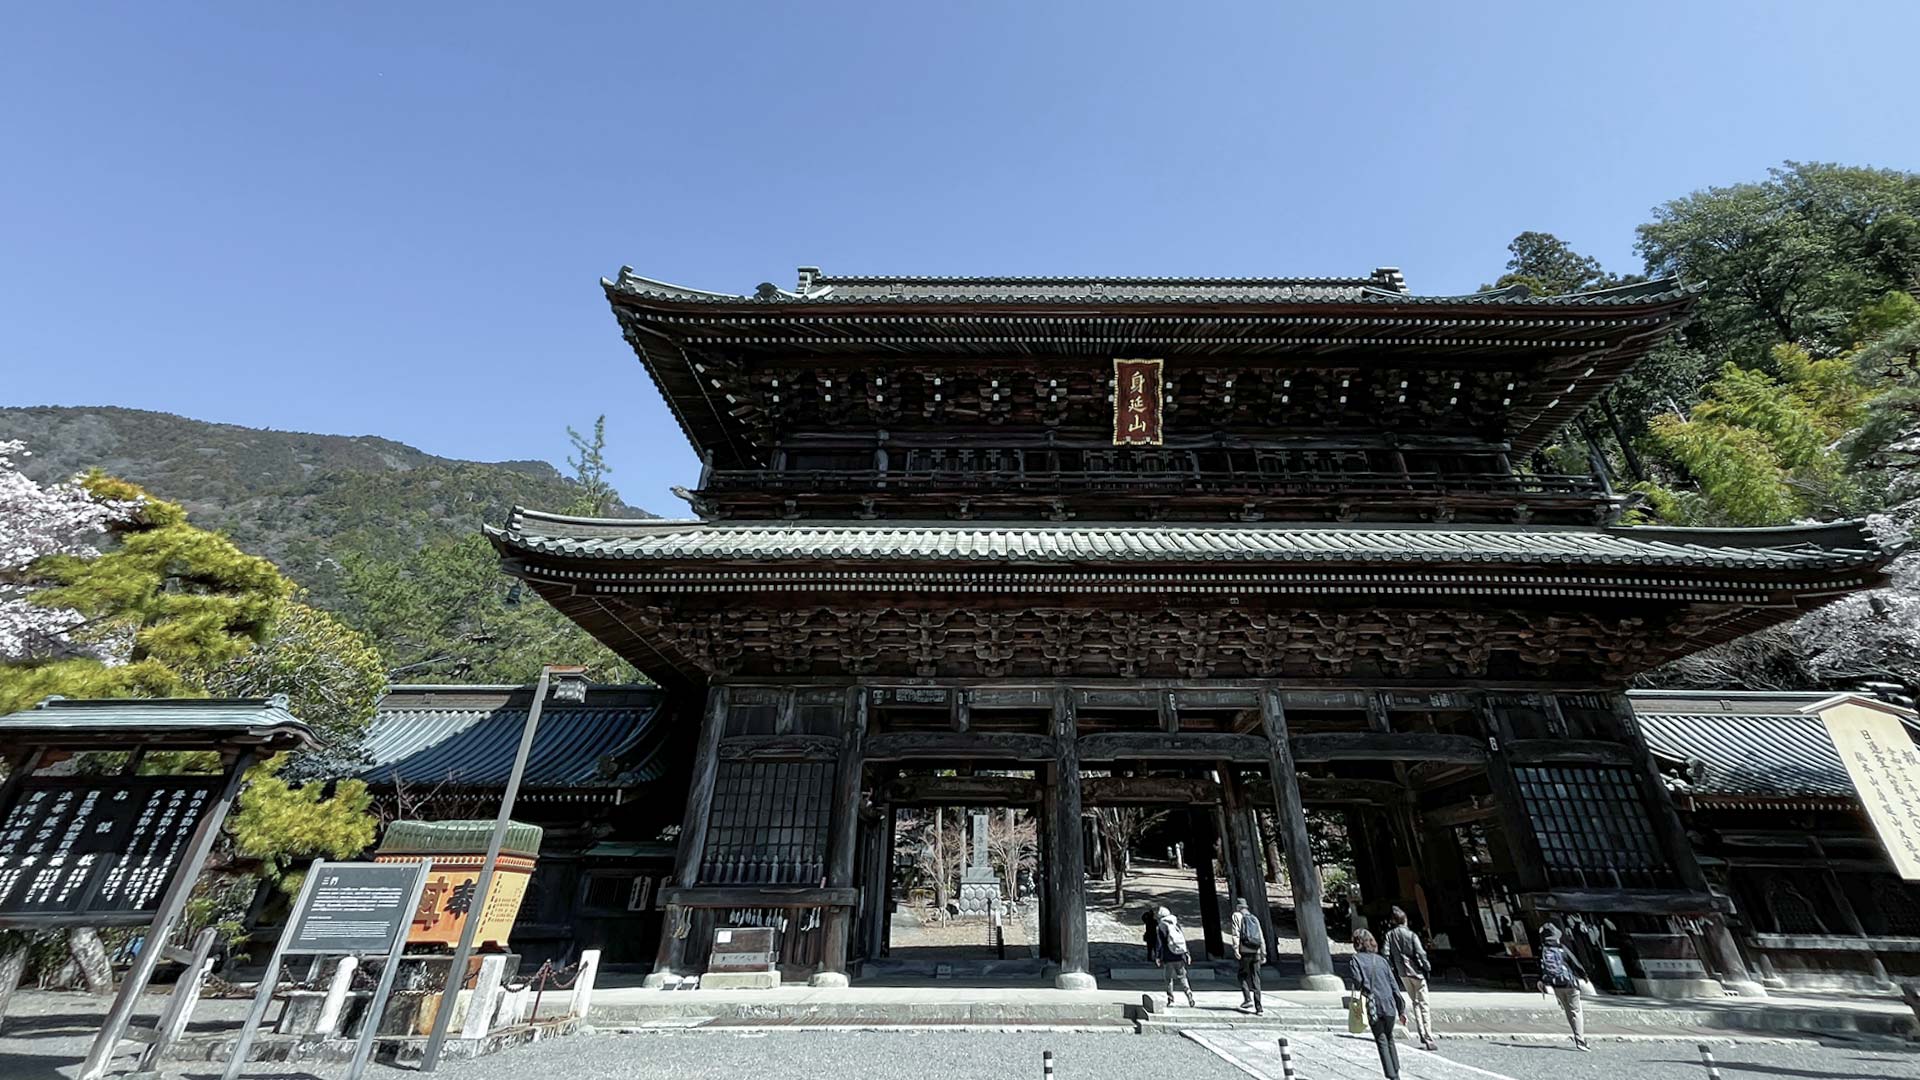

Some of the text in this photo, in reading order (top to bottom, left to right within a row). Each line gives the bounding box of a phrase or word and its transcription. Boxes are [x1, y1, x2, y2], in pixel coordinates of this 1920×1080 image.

[1128, 370, 1147, 432] 身延山
[133, 789, 165, 836] 夕のお勤め
